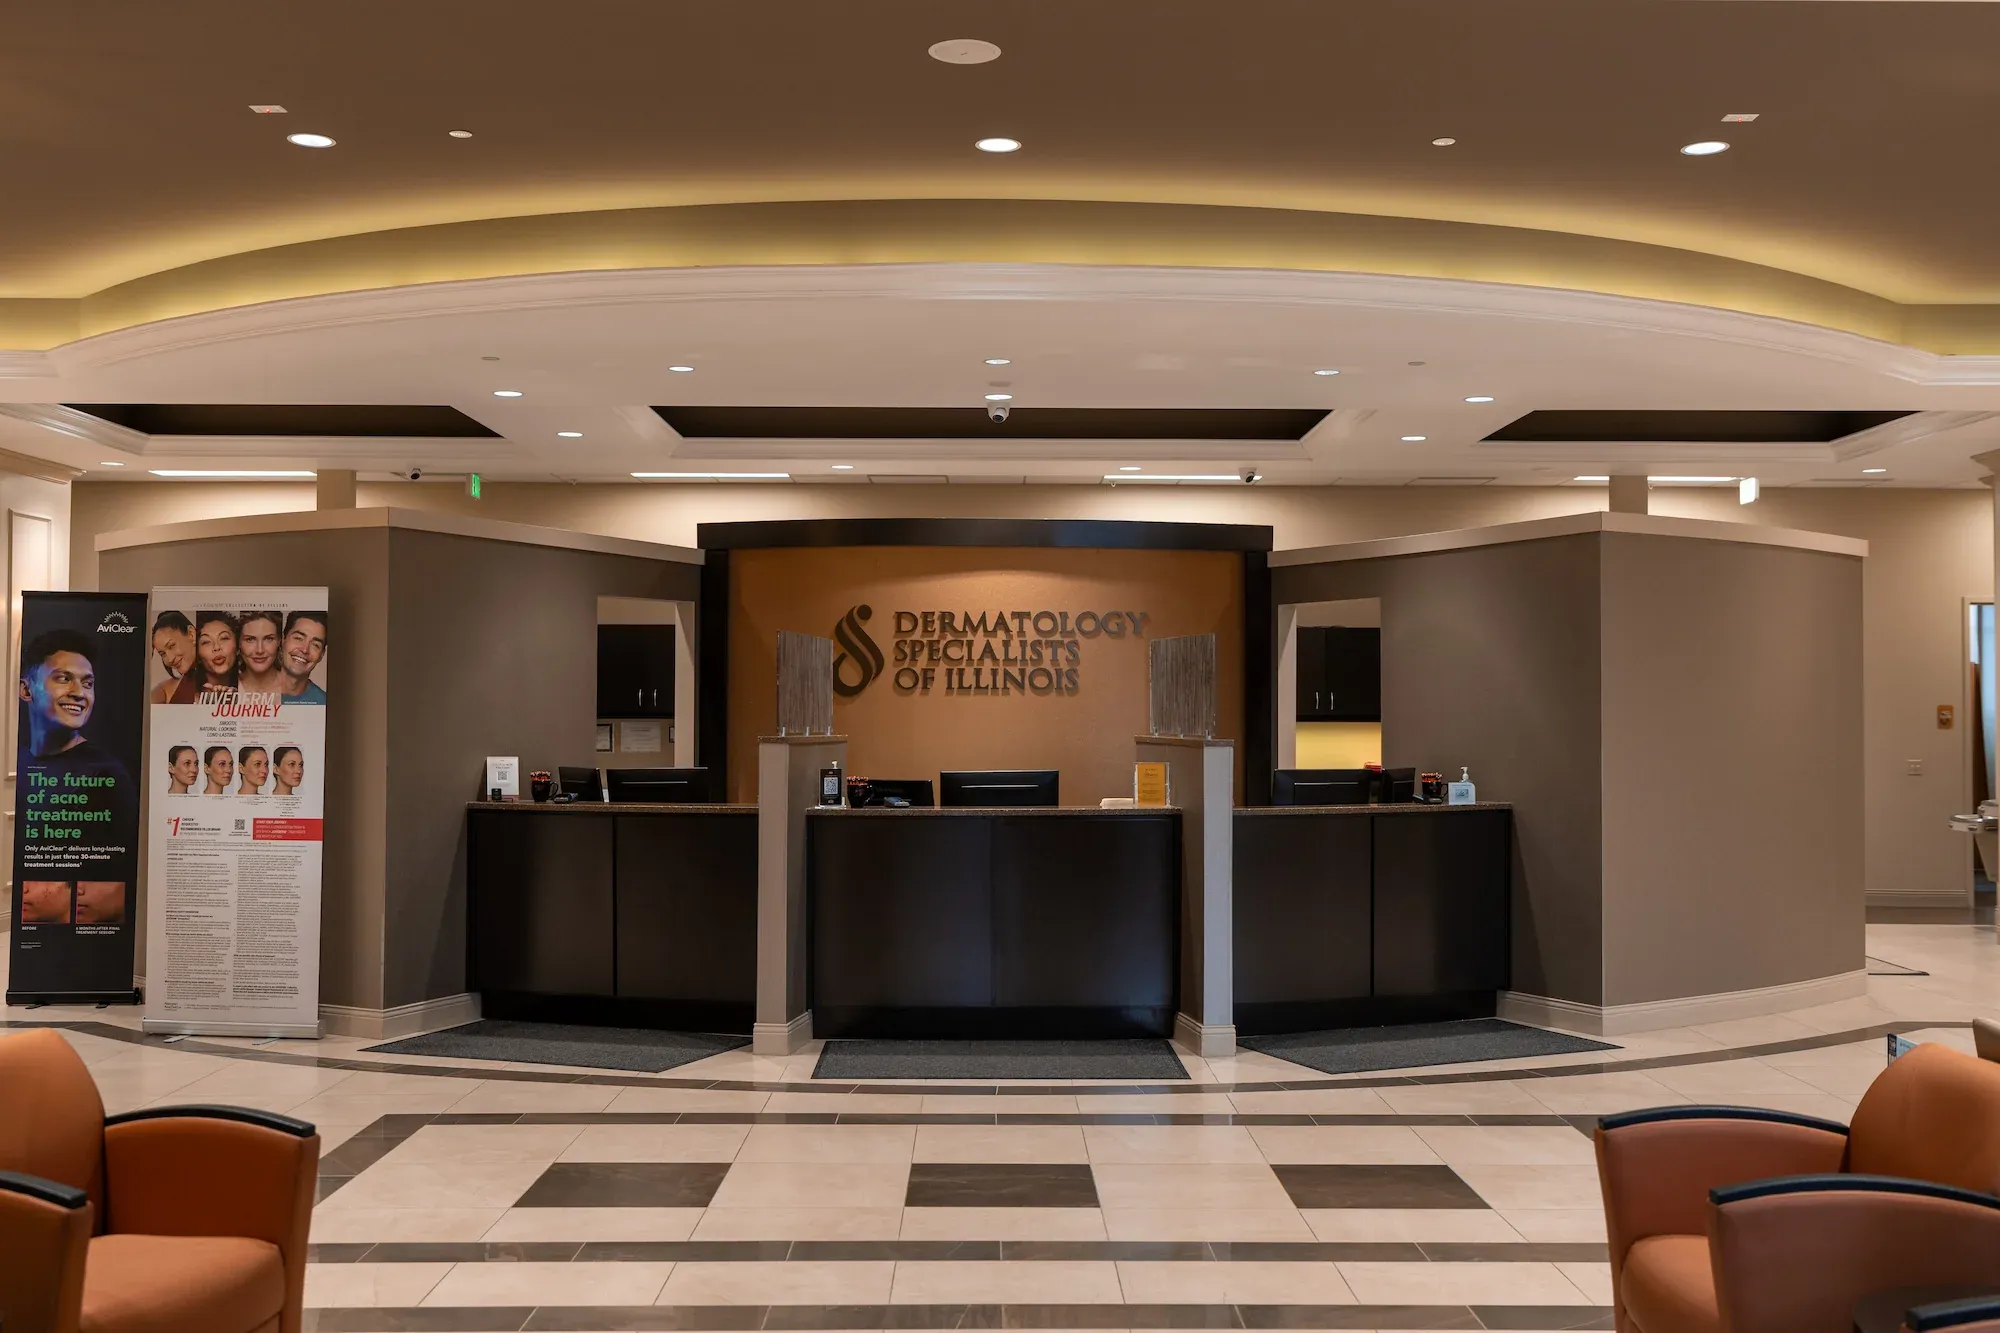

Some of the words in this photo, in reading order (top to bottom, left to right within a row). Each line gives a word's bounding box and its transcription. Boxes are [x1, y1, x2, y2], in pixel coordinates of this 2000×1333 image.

[895, 611, 1147, 635] DERMATOLOGY
[894, 639, 1079, 662] SPECIALISTS
[895, 667, 935, 690] OF
[946, 667, 1079, 690] ILLINOIS
[212, 704, 281, 717] JOURNEY
[27, 772, 59, 787] The
[63, 772, 116, 787] future
[27, 789, 46, 804] of
[49, 793, 89, 804] acne
[26, 808, 111, 821] treatment
[25, 824, 39, 838] is
[44, 824, 82, 838] here
[92, 845, 126, 853] long-lasting
